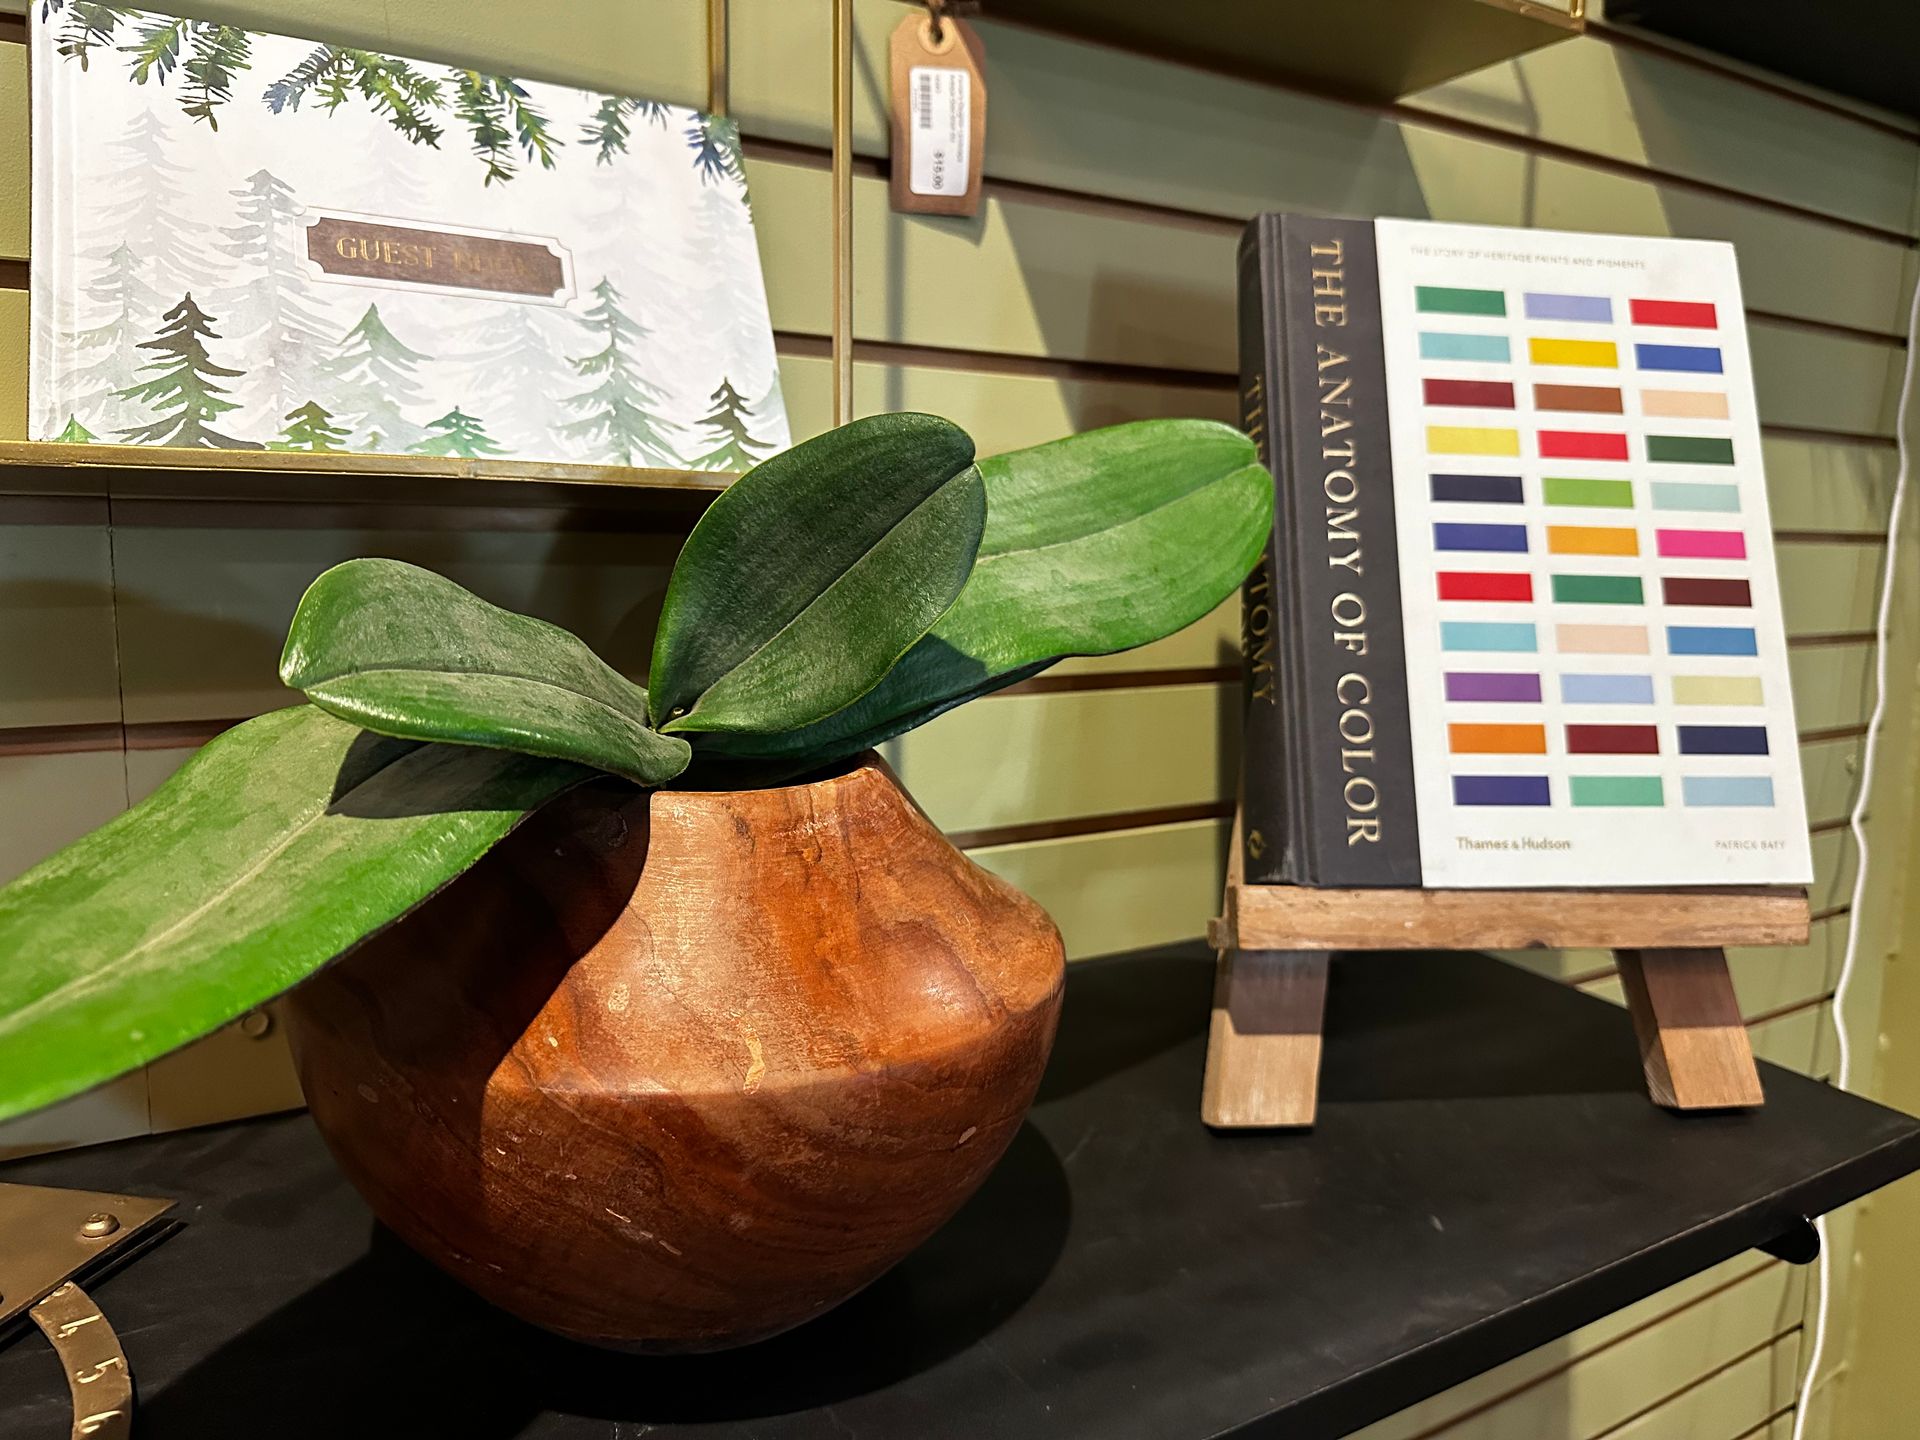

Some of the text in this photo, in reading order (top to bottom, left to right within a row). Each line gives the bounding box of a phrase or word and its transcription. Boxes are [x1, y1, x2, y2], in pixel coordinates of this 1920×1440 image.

[336, 236, 437, 269] GUEST
[1310, 240, 1382, 846] THE ANATOMY OF COLOR
[1455, 834, 1510, 852] Thames
[1520, 835, 1572, 852] Hudson
